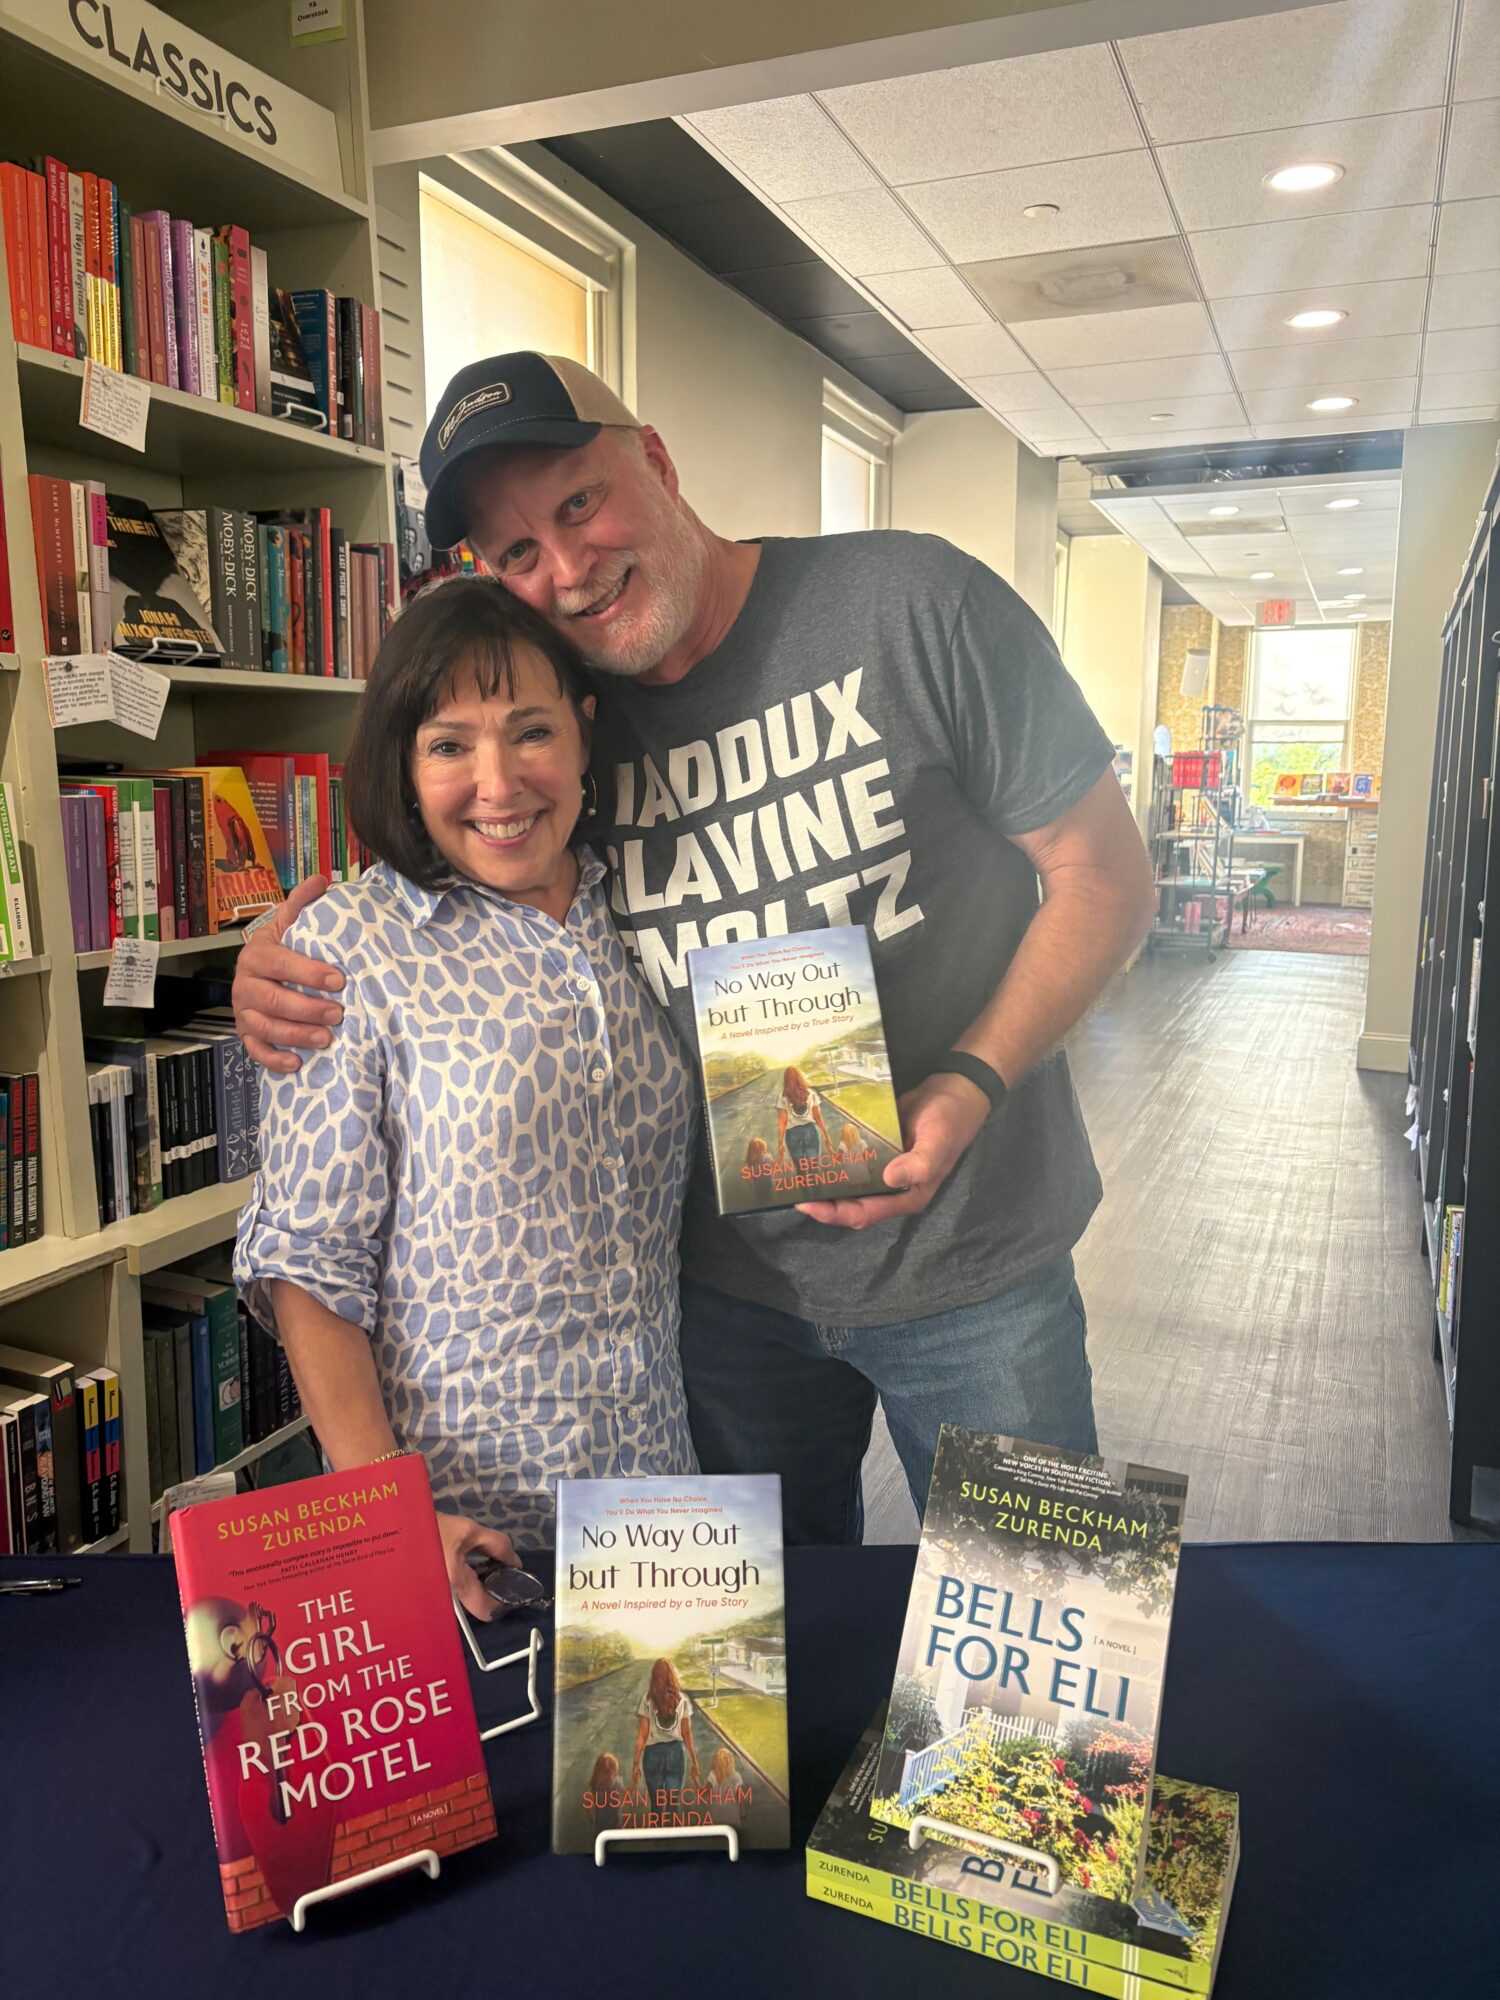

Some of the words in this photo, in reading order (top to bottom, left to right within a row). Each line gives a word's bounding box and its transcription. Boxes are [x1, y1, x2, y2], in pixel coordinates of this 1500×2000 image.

[297, 8, 329, 22] Overstock
[68, 0, 277, 145] CLASSICS
[74, 212, 84, 231] Five
[76, 232, 85, 256] Ways
[76, 257, 84, 267] to
[74, 268, 86, 316] Forgiveness
[222, 511, 237, 598] MOBY-DICK
[242, 517, 257, 603] MOBY-DICK
[139, 609, 181, 627] JONAH
[1262, 600, 1292, 625] EXIT
[8, 849, 17, 873] MAN
[114, 864, 122, 918] 1984
[216, 868, 280, 898] TRIAGE
[14, 898, 22, 931] ELLISON
[217, 894, 250, 913] CLAUDIA
[250, 890, 284, 905] RANKINE
[714, 978, 743, 997] No
[748, 971, 796, 991] Way
[802, 963, 841, 982] Out
[708, 1004, 749, 1027] but
[755, 986, 862, 1019] Through
[720, 1032, 728, 1040] A
[729, 1030, 753, 1039] Novel
[754, 1024, 789, 1036] Inspired
[790, 1022, 801, 1031] by
[812, 1018, 830, 1027] True
[832, 1014, 855, 1024] Story
[14, 1160, 23, 1190] PATRICIA
[28, 1156, 37, 1186] PATRICIA
[741, 1161, 795, 1180] SUSAN
[800, 1149, 877, 1171] BECKHAM
[774, 1171, 849, 1192] ZURENDA
[14, 1190, 23, 1226] HIGHSMITH
[28, 1186, 37, 1222] HIGHSMITH
[1003, 1458, 1018, 1468] NEW
[1019, 1461, 1042, 1472] VOICES
[1050, 1468, 1084, 1481] SOUTHERN
[1038, 1458, 1046, 1466] OF
[1060, 1462, 1077, 1472] MOST
[1078, 1466, 1108, 1479] EXCITING
[218, 1508, 290, 1540] SUSAN
[298, 1482, 398, 1520] BECKHAM
[640, 1496, 653, 1504] You
[691, 1506, 722, 1514] Imagined
[960, 1481, 1031, 1512] SUSAN
[1039, 1499, 1148, 1538] BECKHAM
[262, 1512, 366, 1551] ZURENDA
[582, 1525, 617, 1549] No
[625, 1524, 684, 1553] Way
[692, 1522, 741, 1546] Out
[995, 1512, 1102, 1552] ZURENDA
[245, 1560, 281, 1574] emotionally
[283, 1554, 309, 1566] complex
[310, 1550, 326, 1559] story
[332, 1539, 363, 1554] impossible
[372, 1534, 382, 1543] put
[281, 1565, 298, 1574] PATTI
[300, 1555, 334, 1569] CALLAHAN
[336, 1550, 358, 1560] HENRY
[569, 1564, 621, 1590] but
[630, 1559, 760, 1594] Through
[298, 1590, 355, 1624] THE
[581, 1601, 588, 1610] A
[592, 1600, 620, 1610] Novel
[623, 1599, 667, 1611] Inspired
[670, 1599, 682, 1611] by
[685, 1600, 692, 1608] a
[696, 1598, 718, 1608] True
[720, 1597, 749, 1609] Story
[936, 1574, 1085, 1652] BELLS
[285, 1620, 385, 1675] GIRL
[266, 1674, 351, 1721] FROM
[357, 1654, 413, 1690] THE
[925, 1624, 1030, 1696] FOR
[1049, 1657, 1130, 1722] ELI
[237, 1722, 328, 1780] RED
[341, 1679, 452, 1745] ROSE
[280, 1738, 432, 1818] MOTEL
[582, 1790, 649, 1809] SUSAN
[656, 1787, 753, 1806] BECKHAM
[819, 1860, 871, 1884] ZURENDA
[891, 1877, 970, 1920] BELLS
[978, 1904, 1037, 1941] FOR
[1045, 1924, 1087, 1956] ELI
[823, 1886, 873, 1911] ZURENDA
[894, 1904, 972, 1948] BELLS
[981, 1932, 1040, 1971] FOR
[1046, 1952, 1089, 1987] ELI
